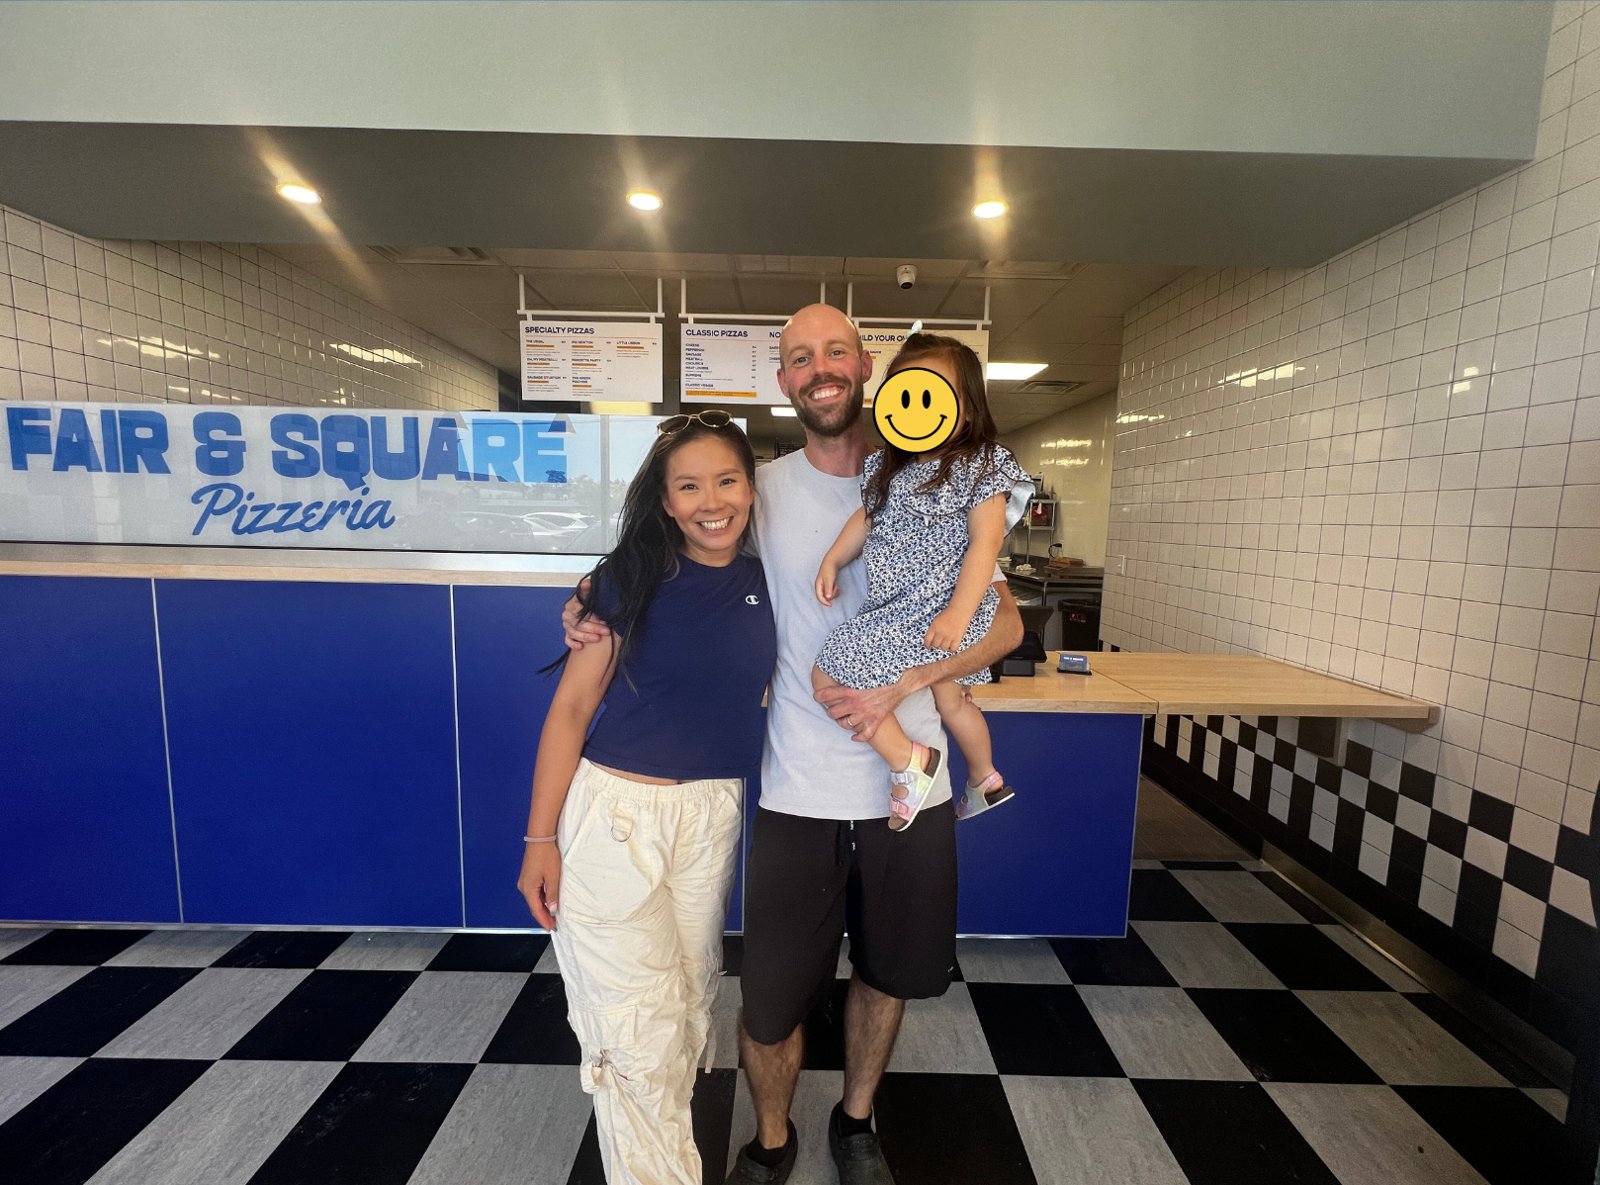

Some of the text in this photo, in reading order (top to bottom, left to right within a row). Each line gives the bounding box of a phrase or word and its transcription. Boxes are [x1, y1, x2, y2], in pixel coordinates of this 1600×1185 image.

[525, 326, 595, 335] SPECIALTY PIZZAS
[685, 329, 749, 338] CLASSIC PIZZAS
[768, 331, 782, 339] NO
[6, 407, 567, 491] FAIR & SQUARE
[191, 482, 396, 536] Pizzeria
